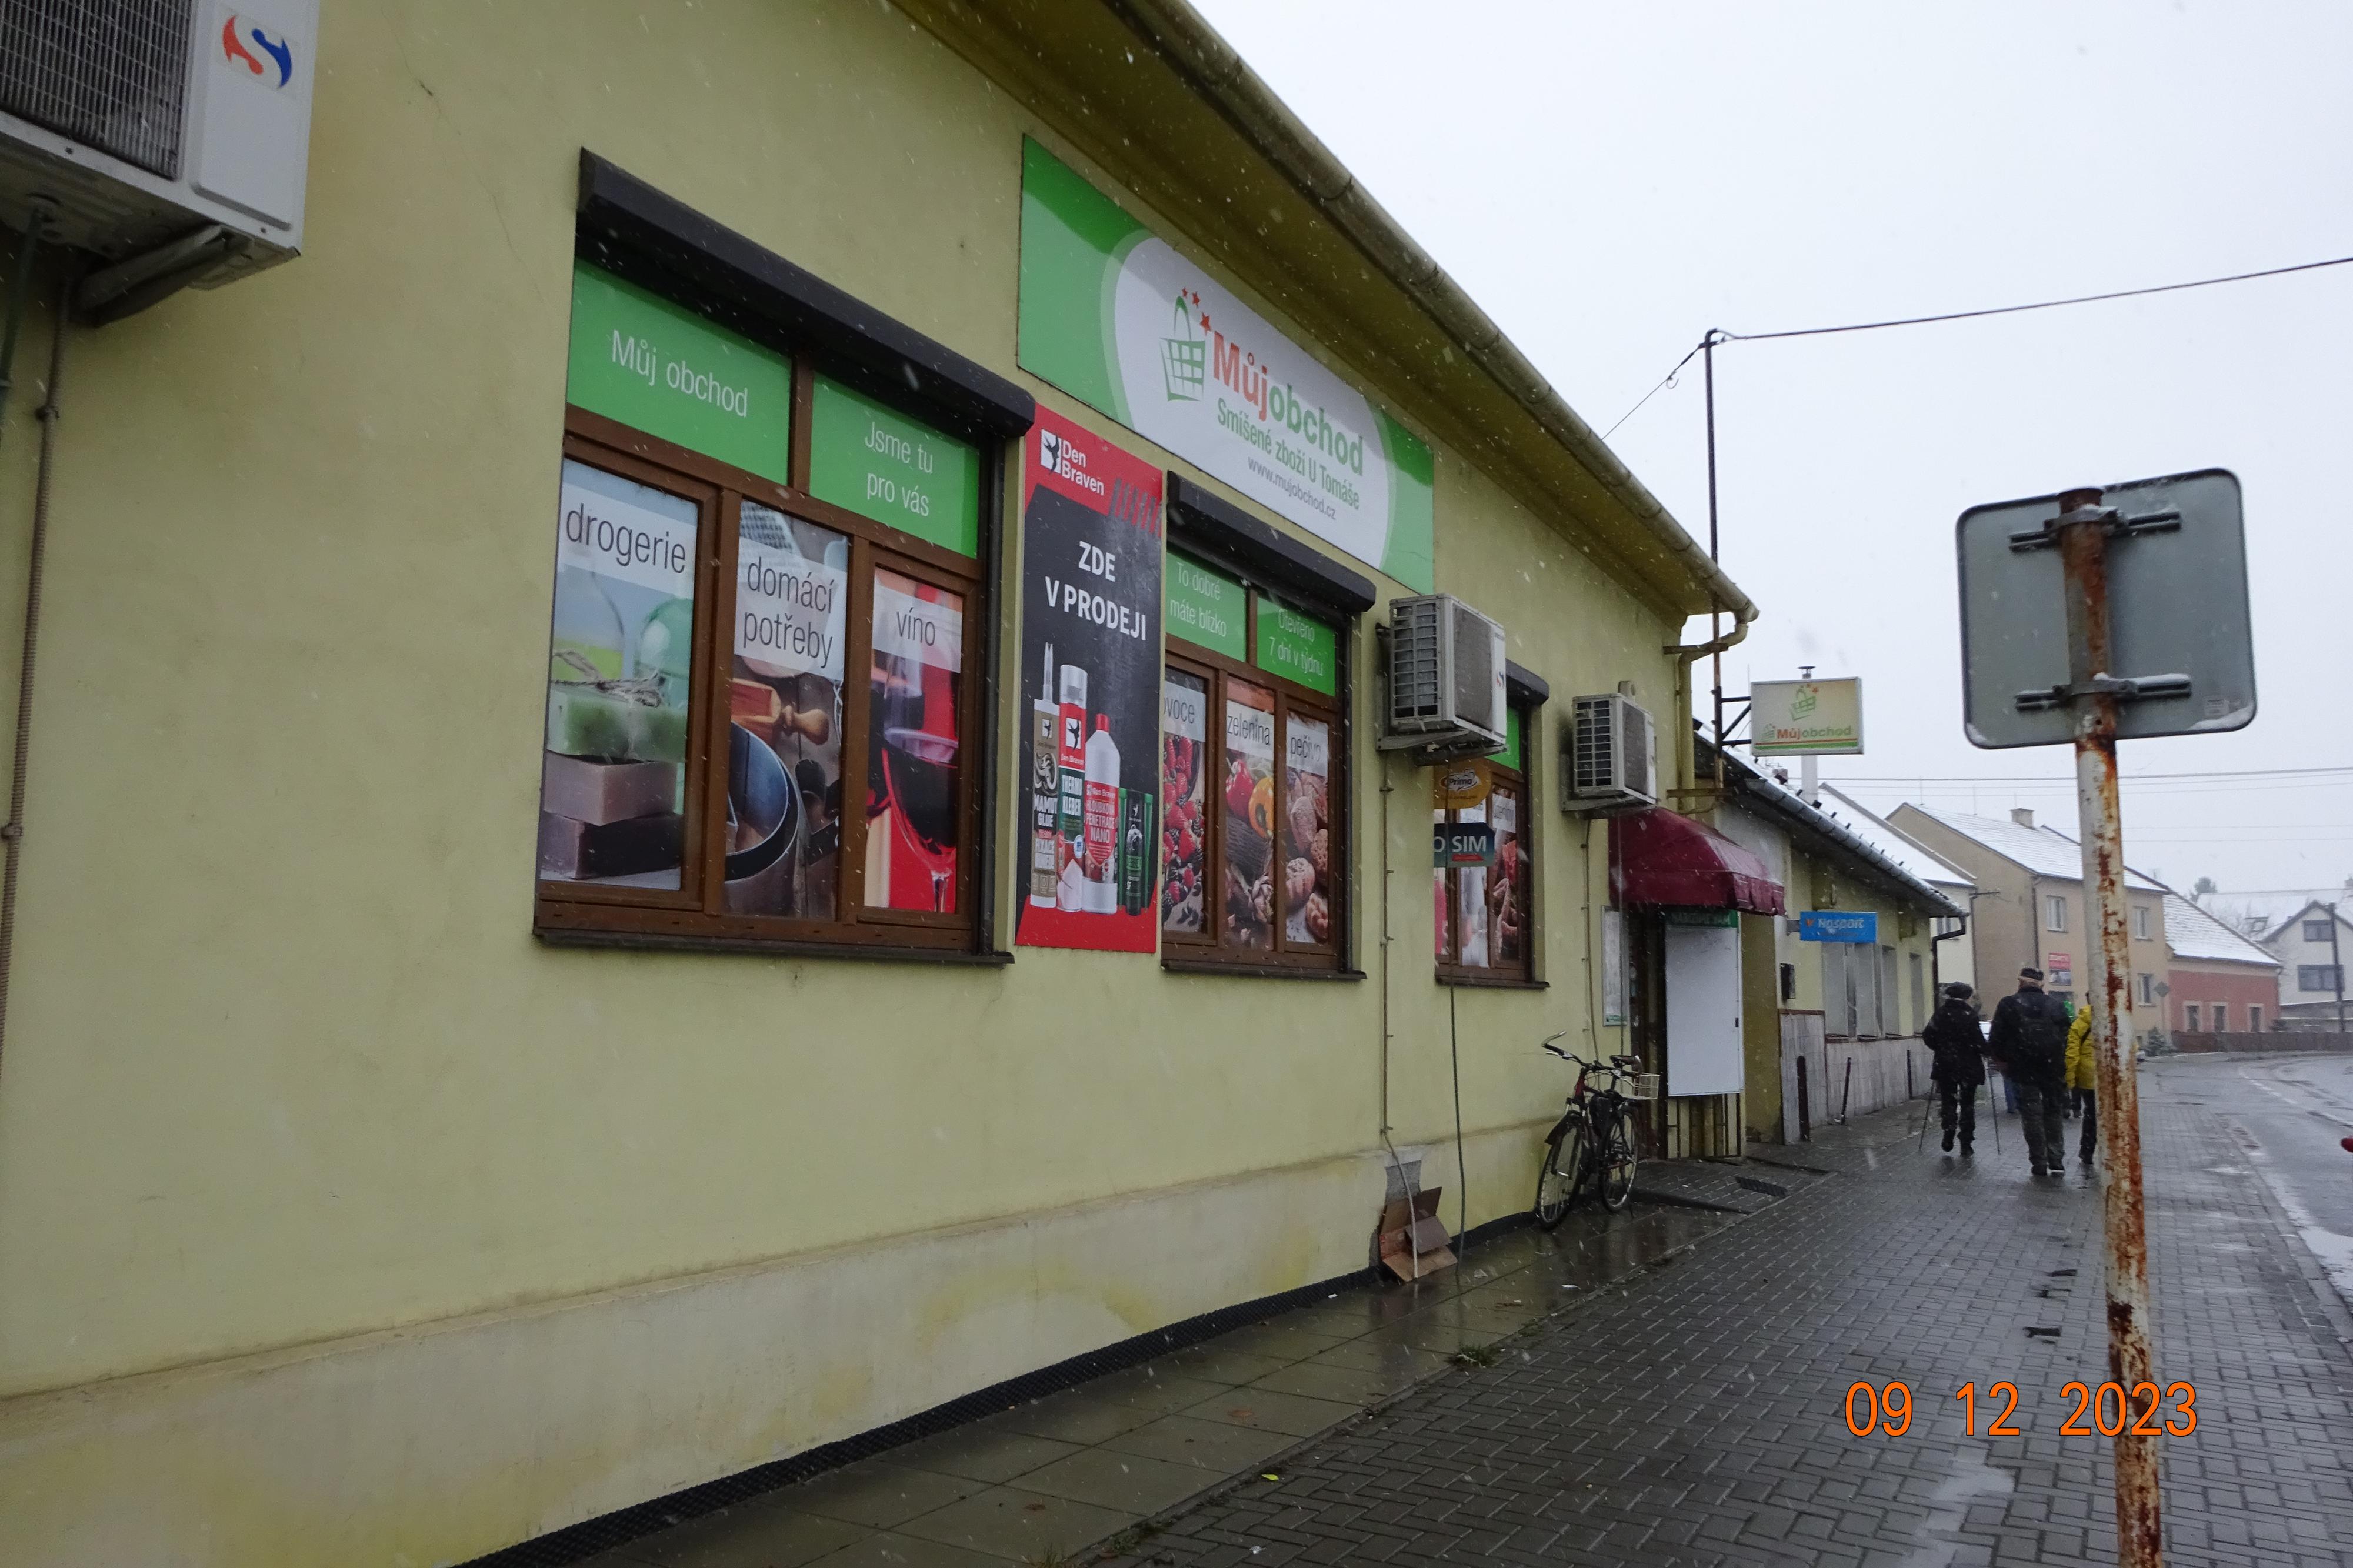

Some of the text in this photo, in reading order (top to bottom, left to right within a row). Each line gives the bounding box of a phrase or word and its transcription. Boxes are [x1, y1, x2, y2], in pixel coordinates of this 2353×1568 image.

[612, 329, 748, 418] Můj obchod
[865, 422, 933, 474] Jsme tu
[1062, 439, 1086, 468] Den
[1218, 397, 1359, 510] Smíšené zboží U Tomáše
[867, 473, 930, 518] pro vás
[1061, 460, 1104, 496] Braven
[1248, 456, 1336, 521] www.mujobchod.cz
[565, 503, 686, 573] drogerie
[1079, 541, 1115, 582] ZDE
[1177, 562, 1221, 601] To dobré
[746, 556, 834, 615] domácí
[896, 607, 936, 646] víno
[1045, 576, 1146, 640] V PRODEJI
[1170, 599, 1227, 638] máte blízko
[742, 609, 834, 669] potřeby
[1269, 636, 1275, 656] 7
[1227, 713, 1271, 746] zelenina
[1290, 735, 1322, 762] pečivo
[1452, 835, 1487, 853] SIM
